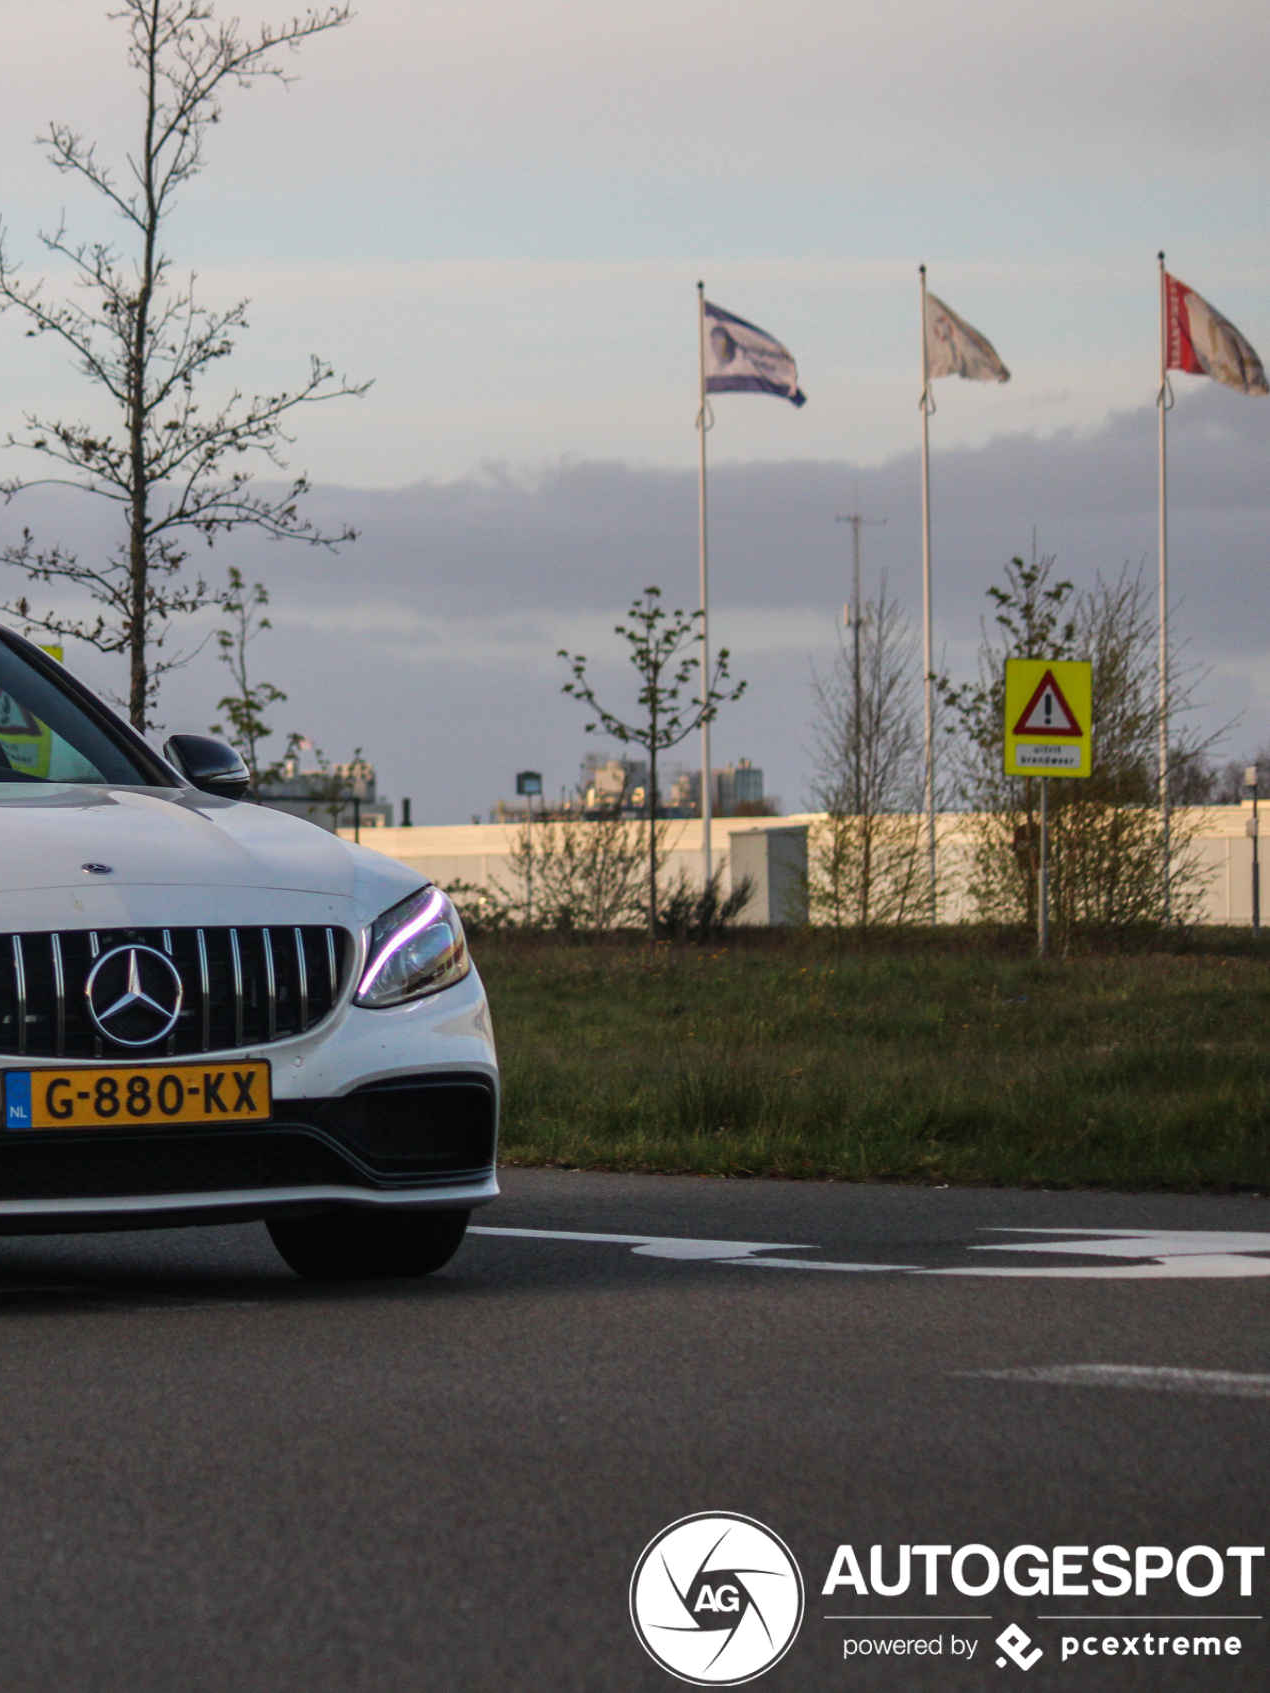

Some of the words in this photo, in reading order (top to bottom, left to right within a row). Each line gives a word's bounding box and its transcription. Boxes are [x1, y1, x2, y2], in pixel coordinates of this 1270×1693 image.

[1034, 746, 1061, 754] uitrit
[1020, 755, 1074, 765] brandweer
[45, 1070, 257, 1119] G-880-KX
[9, 1105, 28, 1118] NL
